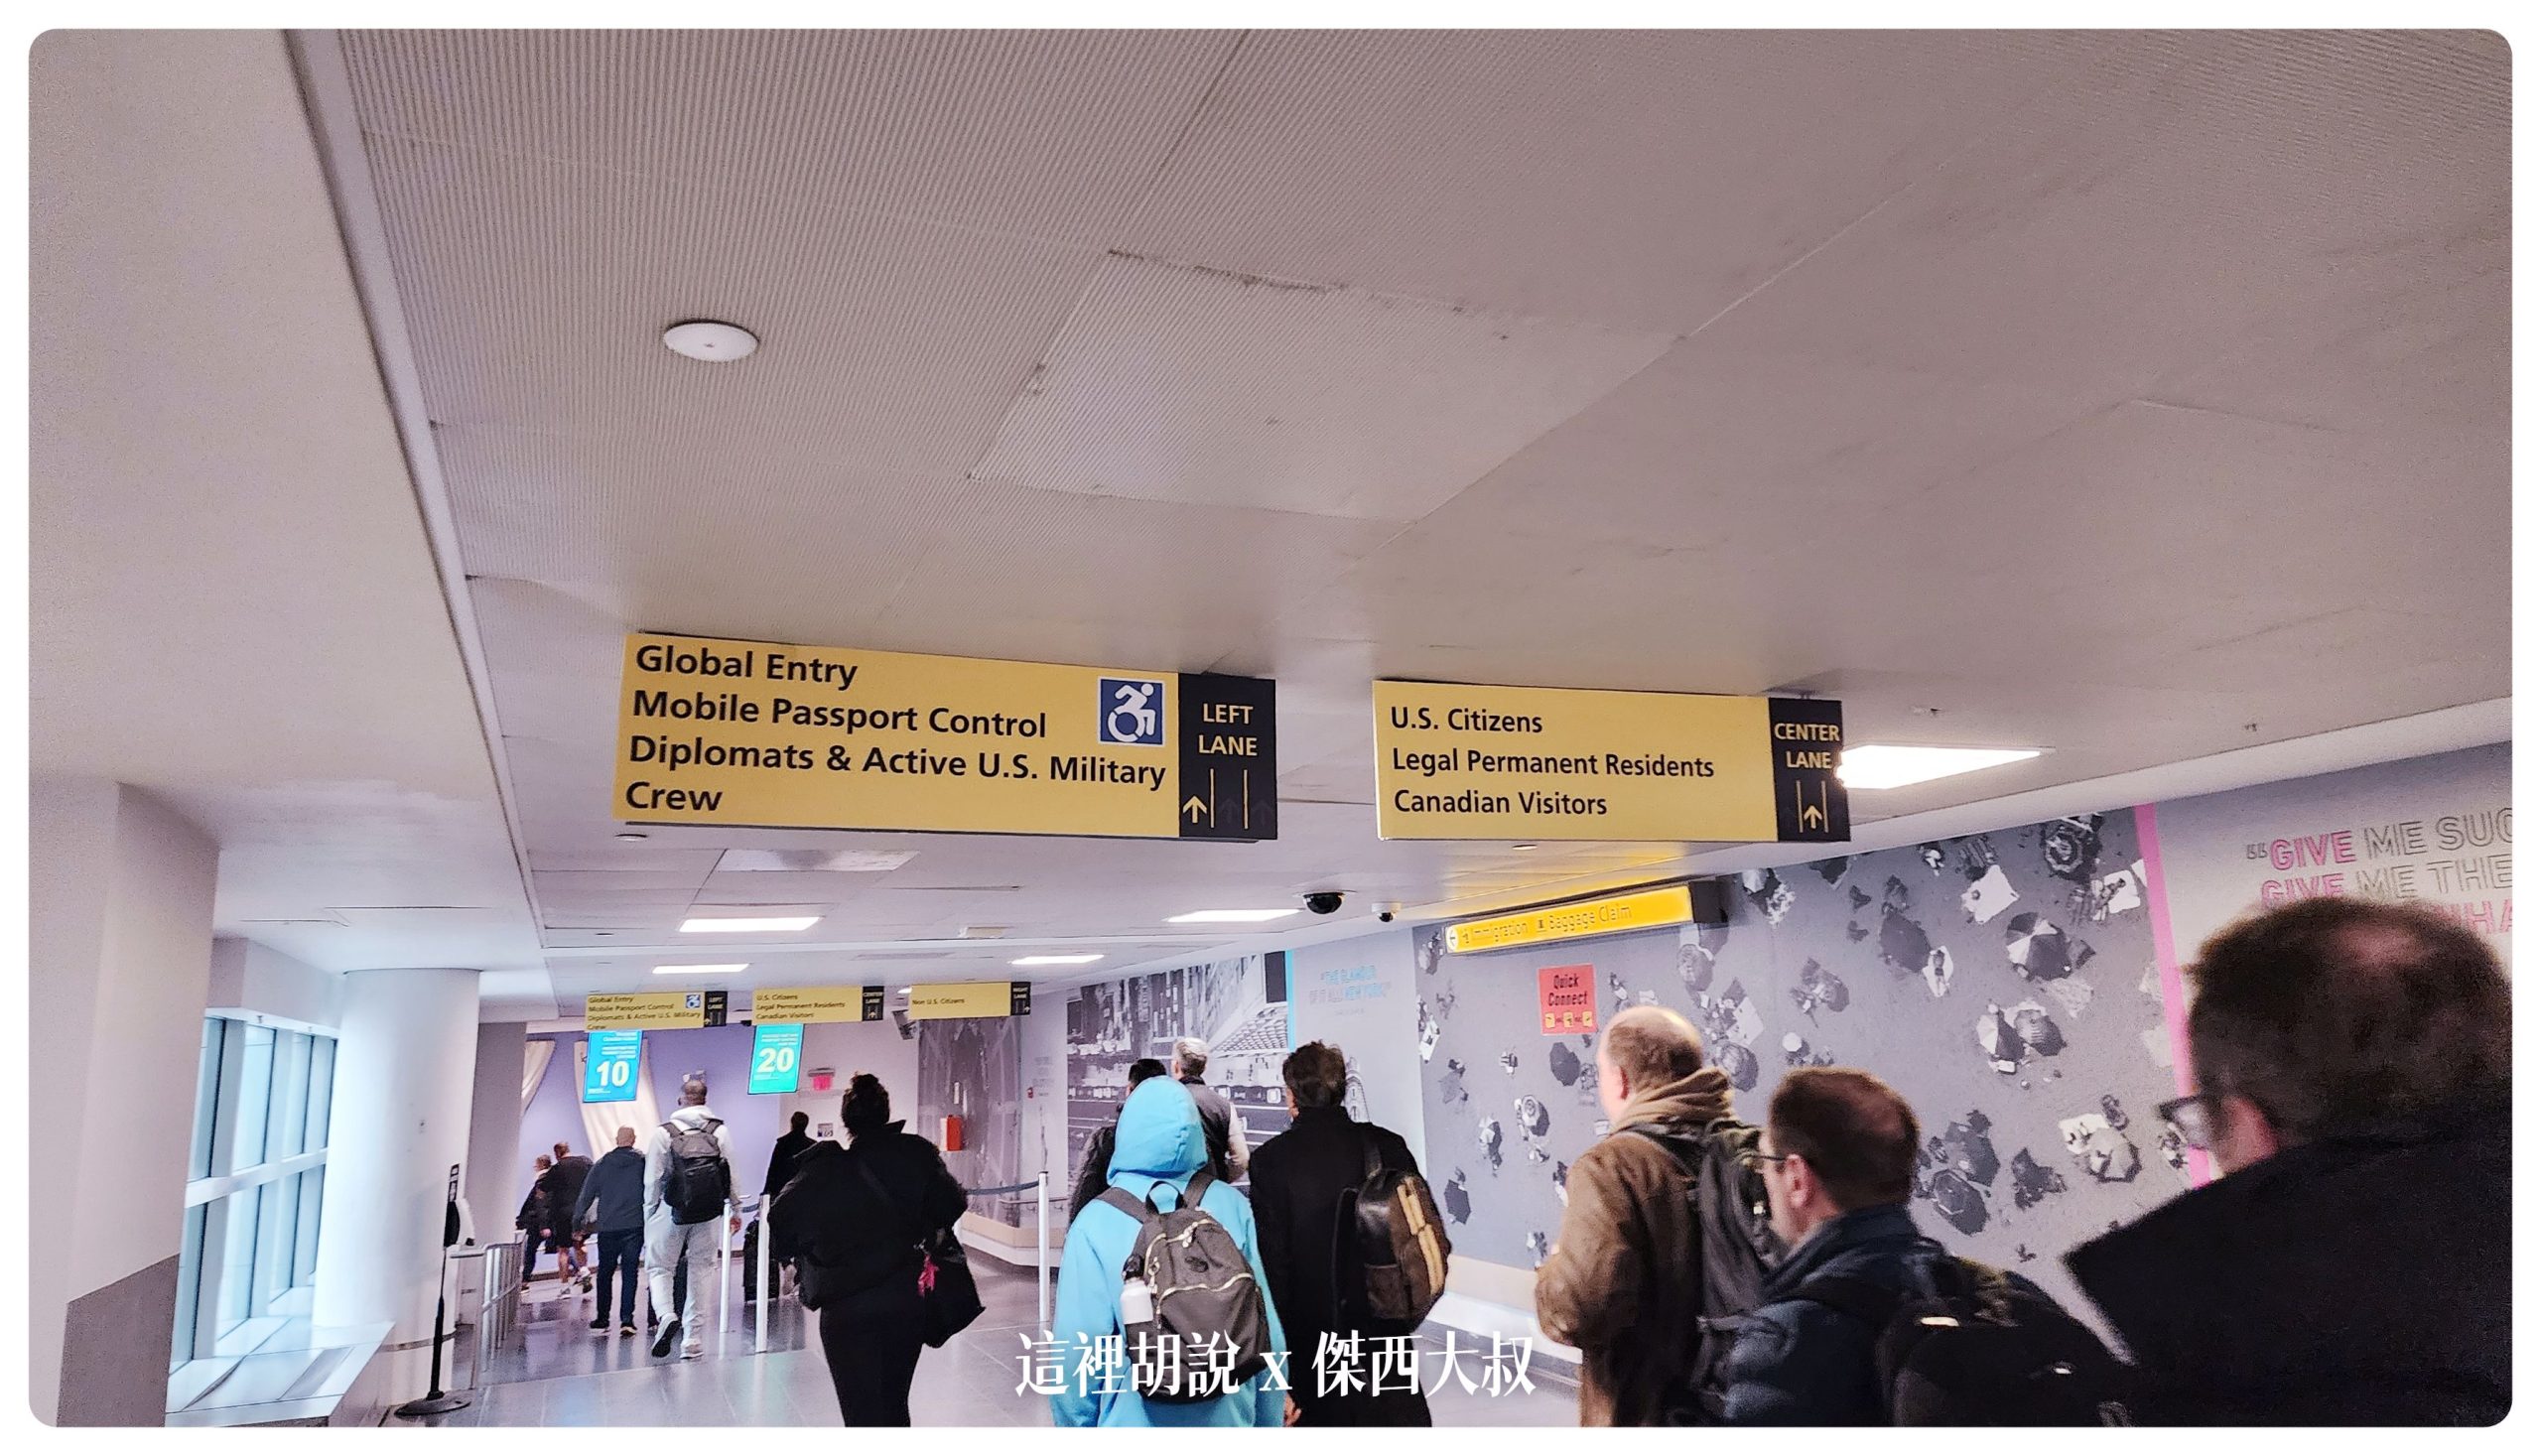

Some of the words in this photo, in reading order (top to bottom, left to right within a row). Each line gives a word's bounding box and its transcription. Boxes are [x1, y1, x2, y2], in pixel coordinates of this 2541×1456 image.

[636, 645, 752, 678] Global
[767, 655, 858, 691] Entry
[632, 690, 759, 724] Mobile
[772, 701, 918, 740] Passport
[929, 708, 1046, 738] Control
[1202, 702, 1254, 726] LEFT
[1391, 707, 1439, 730] U.S.
[1447, 708, 1543, 733] Citizens
[1198, 733, 1258, 758] LANE
[1774, 722, 1839, 742] CENTER
[629, 735, 814, 773] Diplomats
[826, 747, 853, 773] &
[864, 747, 967, 777] Active
[979, 752, 1038, 780] U.S.
[1050, 755, 1166, 791] Military
[1393, 747, 1459, 778] Legal
[1468, 750, 1599, 776] Permanent
[1606, 753, 1715, 778] Residents
[1786, 750, 1831, 770] LANE
[626, 781, 723, 813] Crew
[1394, 789, 1511, 815] Canadian
[1520, 791, 1608, 816] Visitors
[2363, 821, 2428, 860] ME
[2355, 864, 2419, 899] ME
[2426, 854, 2512, 895] THE
[1549, 908, 1596, 933] Baggage
[1599, 903, 1633, 922] Claim
[1553, 973, 1579, 990] Quick
[1548, 991, 1587, 1006] Connect
[756, 1047, 795, 1073] 20
[596, 1060, 630, 1088] 10
